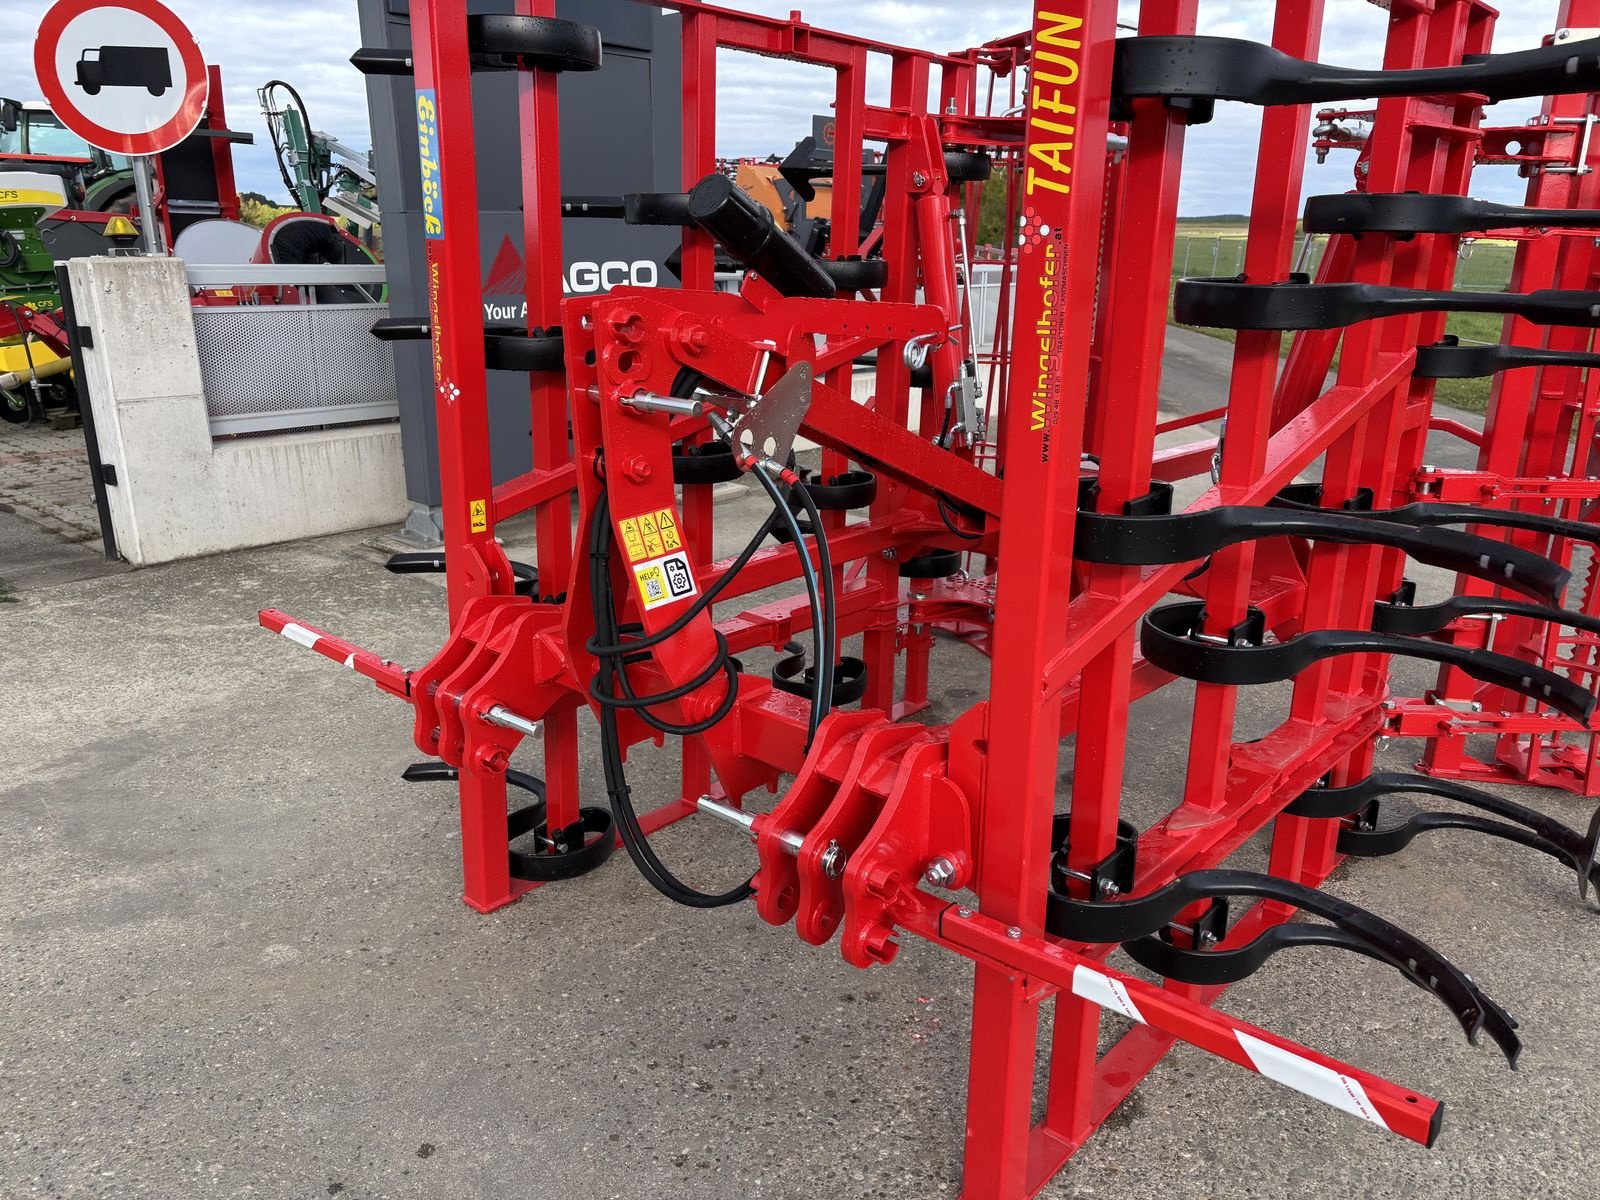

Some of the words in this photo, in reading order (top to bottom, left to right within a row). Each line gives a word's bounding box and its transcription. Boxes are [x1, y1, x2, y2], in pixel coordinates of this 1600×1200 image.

[1027, 11, 1083, 195] TAIFUN
[417, 95, 441, 235] Einböck
[484, 303, 517, 320] Your
[1061, 243, 1069, 307] LANDMASCHINEN
